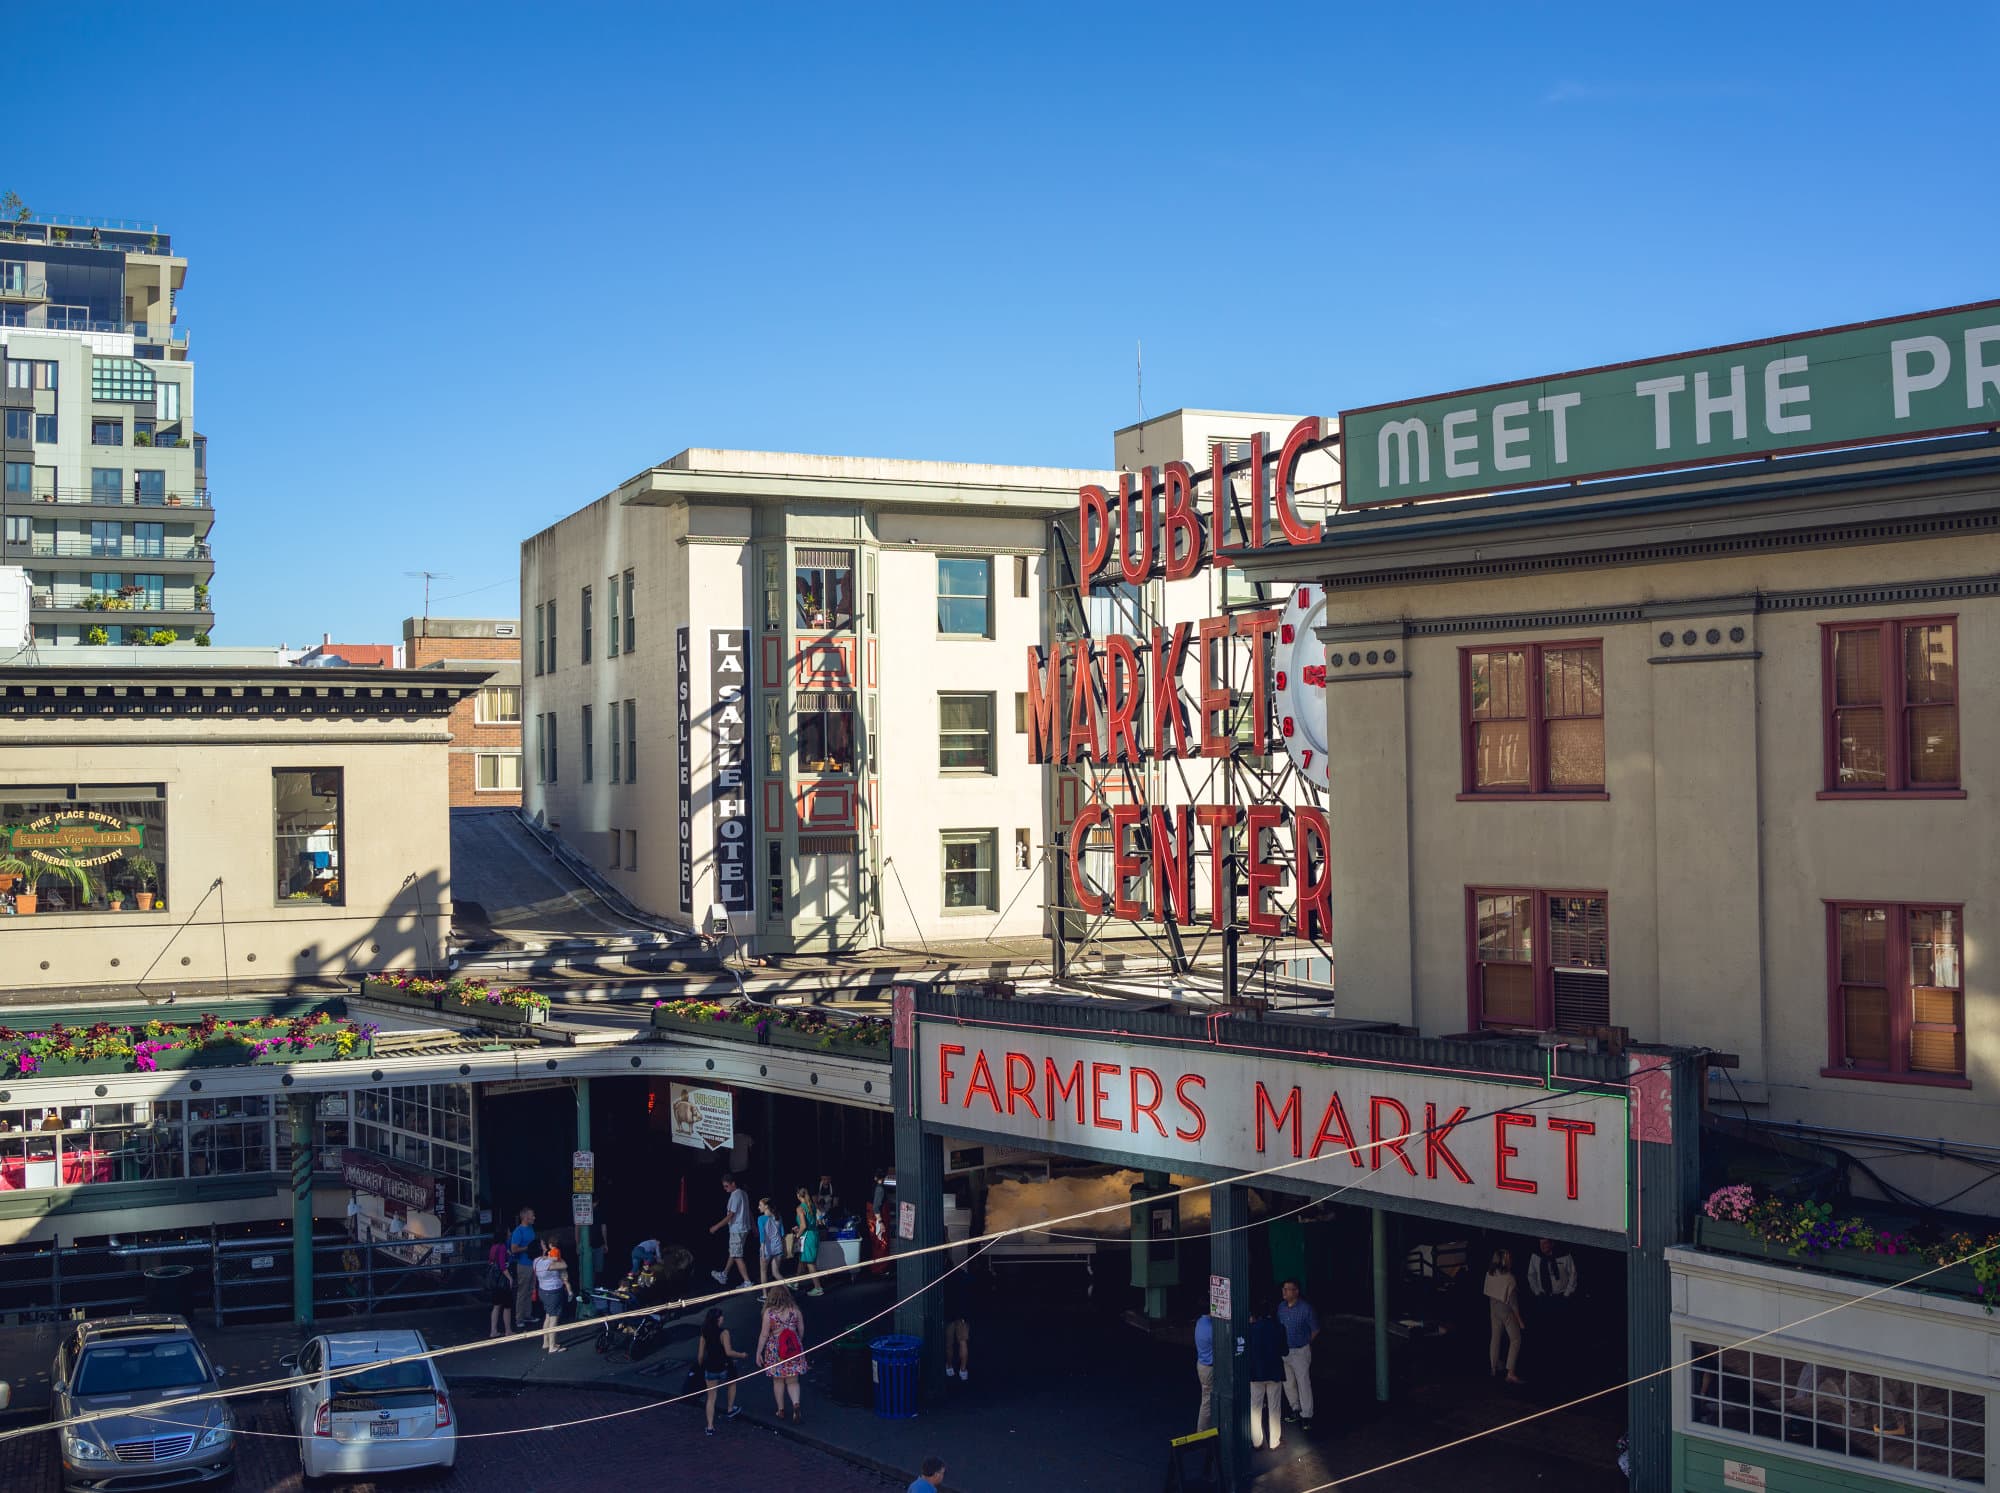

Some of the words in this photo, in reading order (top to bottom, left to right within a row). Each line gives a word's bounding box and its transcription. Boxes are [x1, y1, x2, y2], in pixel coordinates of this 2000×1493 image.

[1378, 391, 1581, 488] MEET
[1636, 355, 1812, 450] THE
[1079, 416, 1327, 596] PUBLIC
[678, 633, 687, 672] LA
[717, 633, 743, 673] LA
[1027, 608, 1281, 765] MARKET
[679, 681, 689, 785] SALLE
[718, 685, 744, 787] SALLE
[30, 815, 52, 830] PIKE
[55, 810, 85, 821] PLACE
[88, 811, 122, 829] DENTAL
[31, 849, 71, 868] GENERAL
[74, 848, 123, 869] DENTISTRY
[680, 800, 690, 903] HOTEL
[719, 799, 746, 902] HOTEL
[1070, 804, 1333, 943] CENTER
[939, 1042, 1207, 1143] FARMERS
[1255, 1081, 1597, 1201] MARKET
